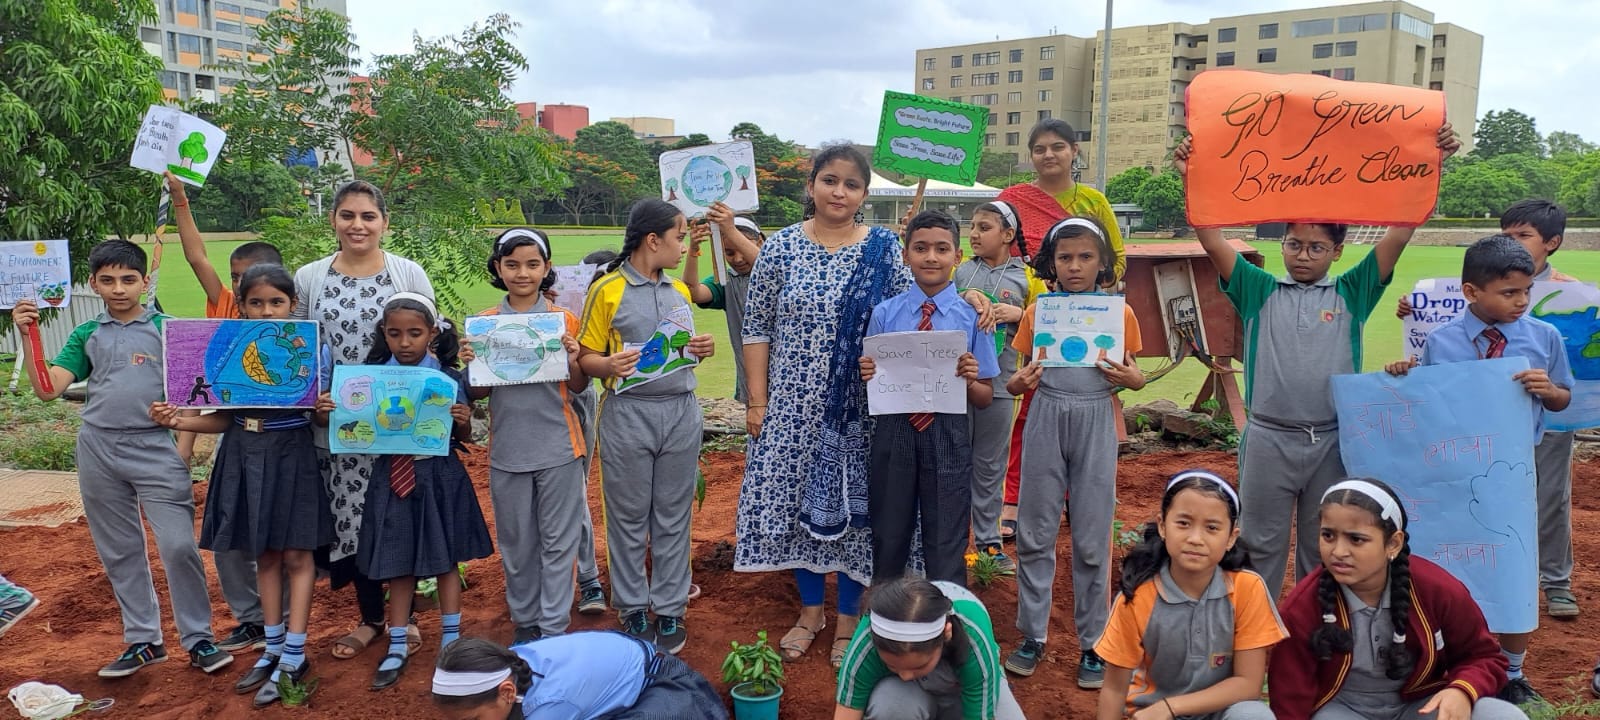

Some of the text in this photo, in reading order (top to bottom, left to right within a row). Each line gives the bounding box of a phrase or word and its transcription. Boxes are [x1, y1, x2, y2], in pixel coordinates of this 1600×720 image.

[1282, 90, 1424, 161] Green
[1232, 149, 1347, 202] Breathe
[877, 341, 960, 360] Save Trees
[878, 373, 950, 394] Save Life
